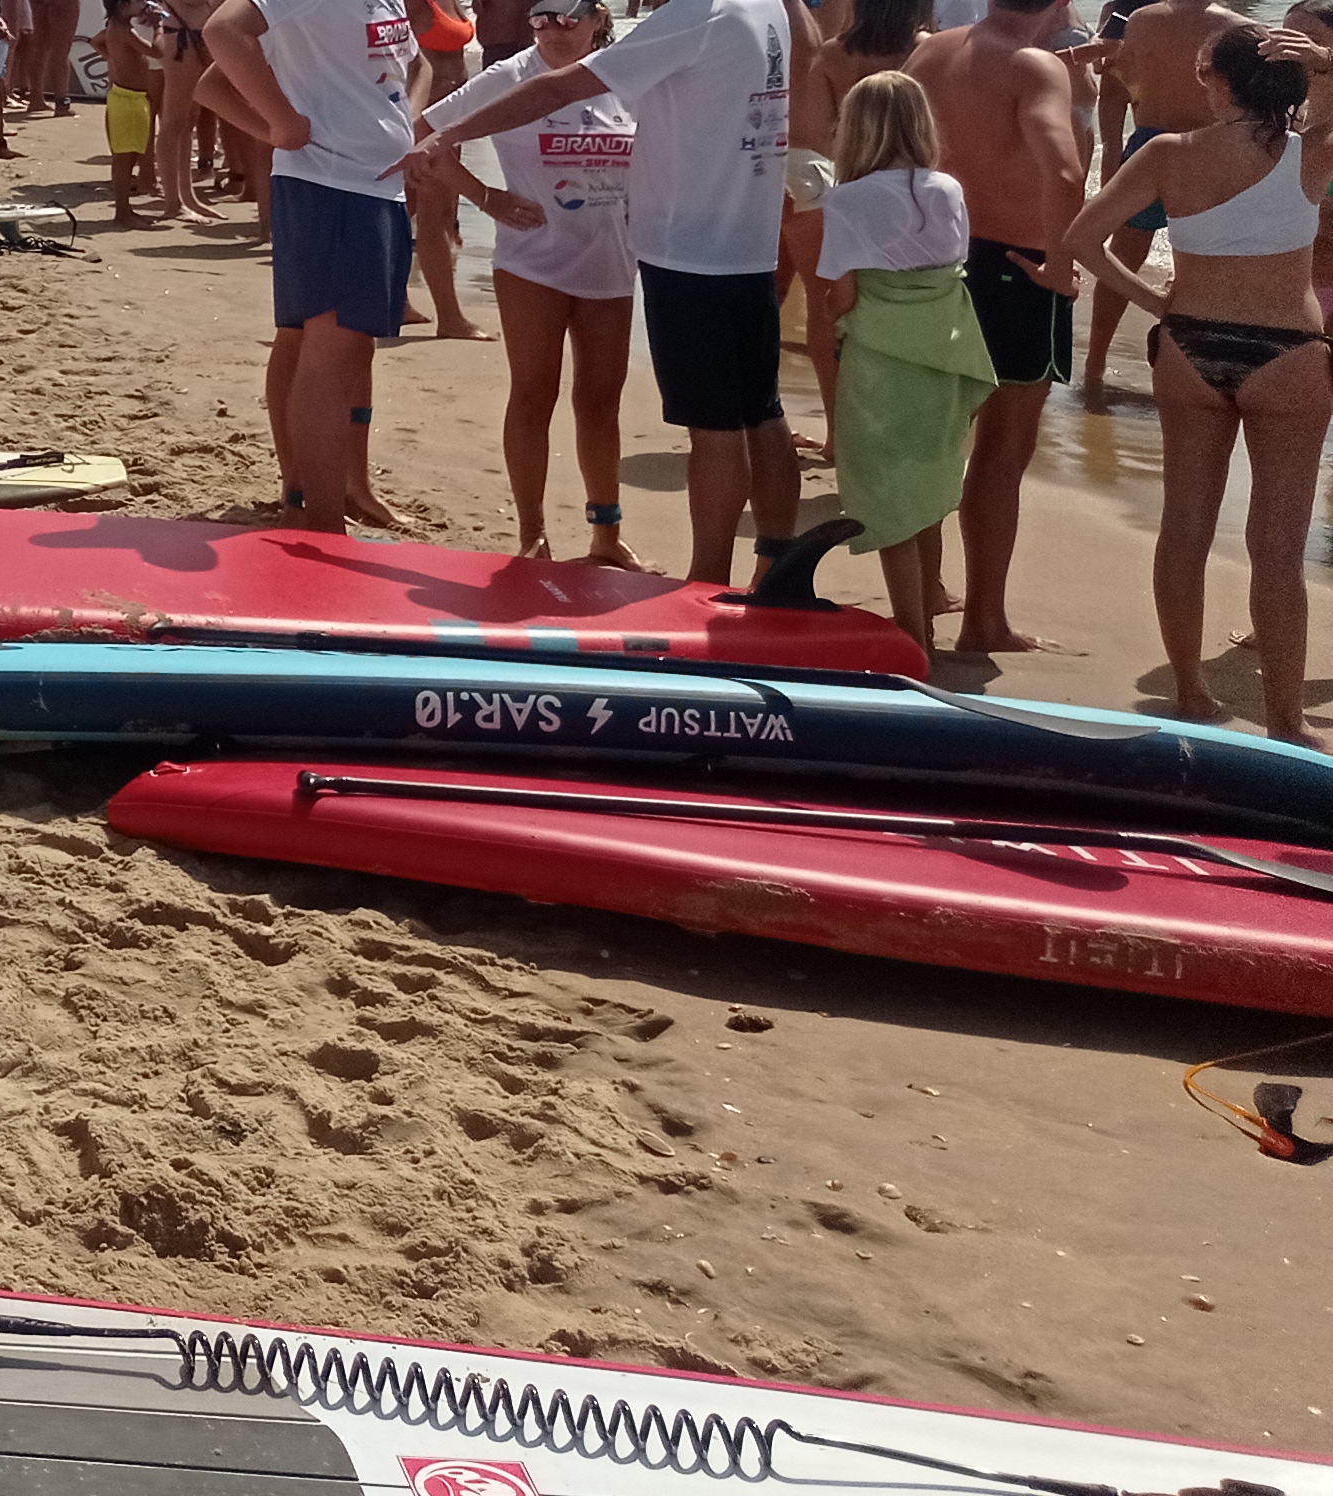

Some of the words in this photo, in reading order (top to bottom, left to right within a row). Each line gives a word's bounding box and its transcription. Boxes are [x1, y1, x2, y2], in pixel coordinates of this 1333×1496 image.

[546, 136, 635, 154] BRANDT
[415, 689, 562, 733] SAR.10
[637, 705, 795, 743] WATTSUP
